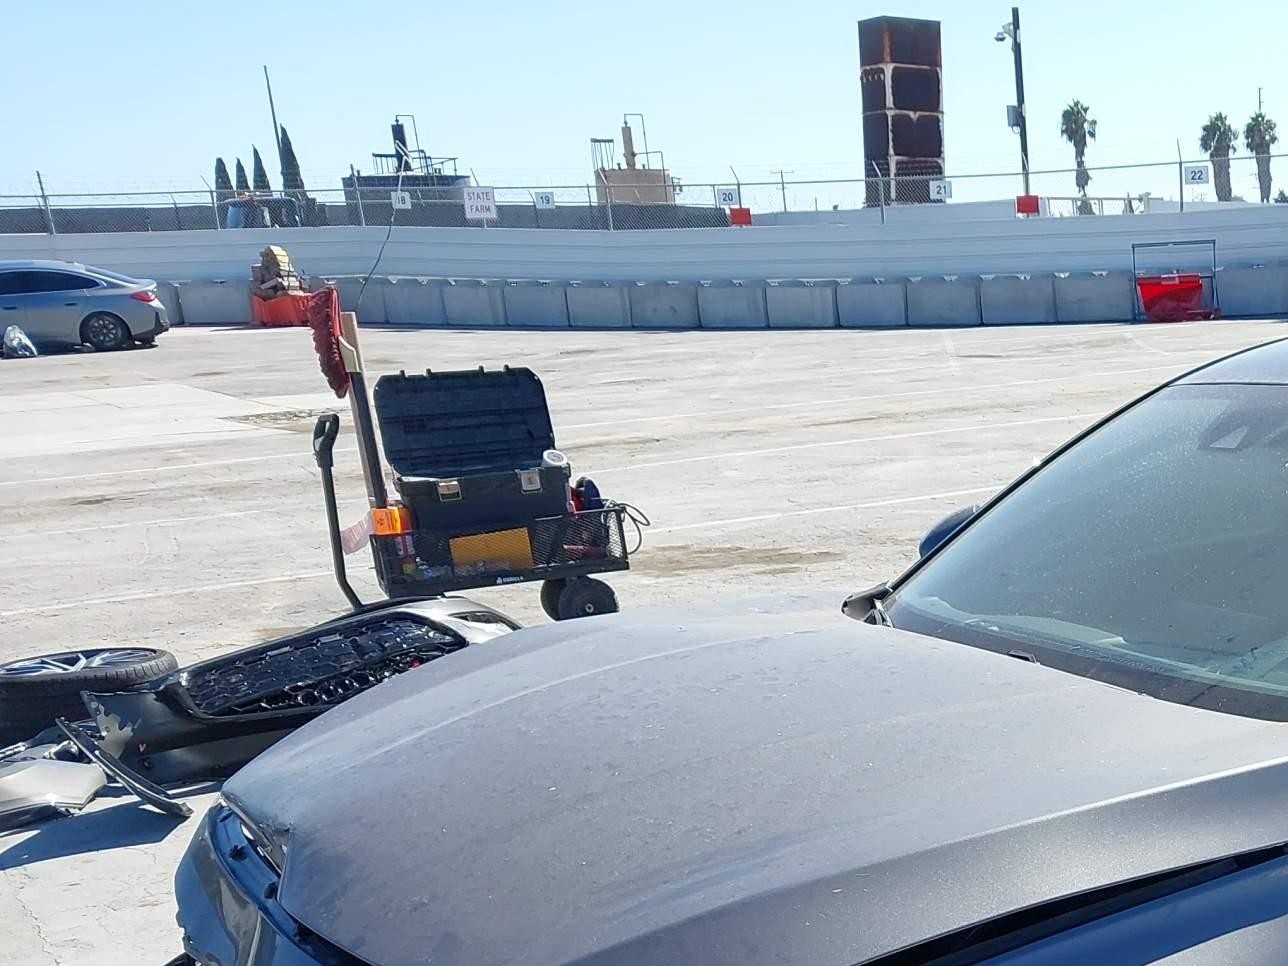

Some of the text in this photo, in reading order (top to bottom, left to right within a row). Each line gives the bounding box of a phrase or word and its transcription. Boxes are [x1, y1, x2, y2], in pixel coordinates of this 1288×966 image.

[1190, 169, 1204, 181] 22
[936, 184, 947, 195] 21
[397, 195, 406, 205] 18
[467, 191, 490, 201] STATE
[540, 195, 550, 205] 19
[722, 191, 734, 202] 20
[470, 204, 491, 214] FARM
